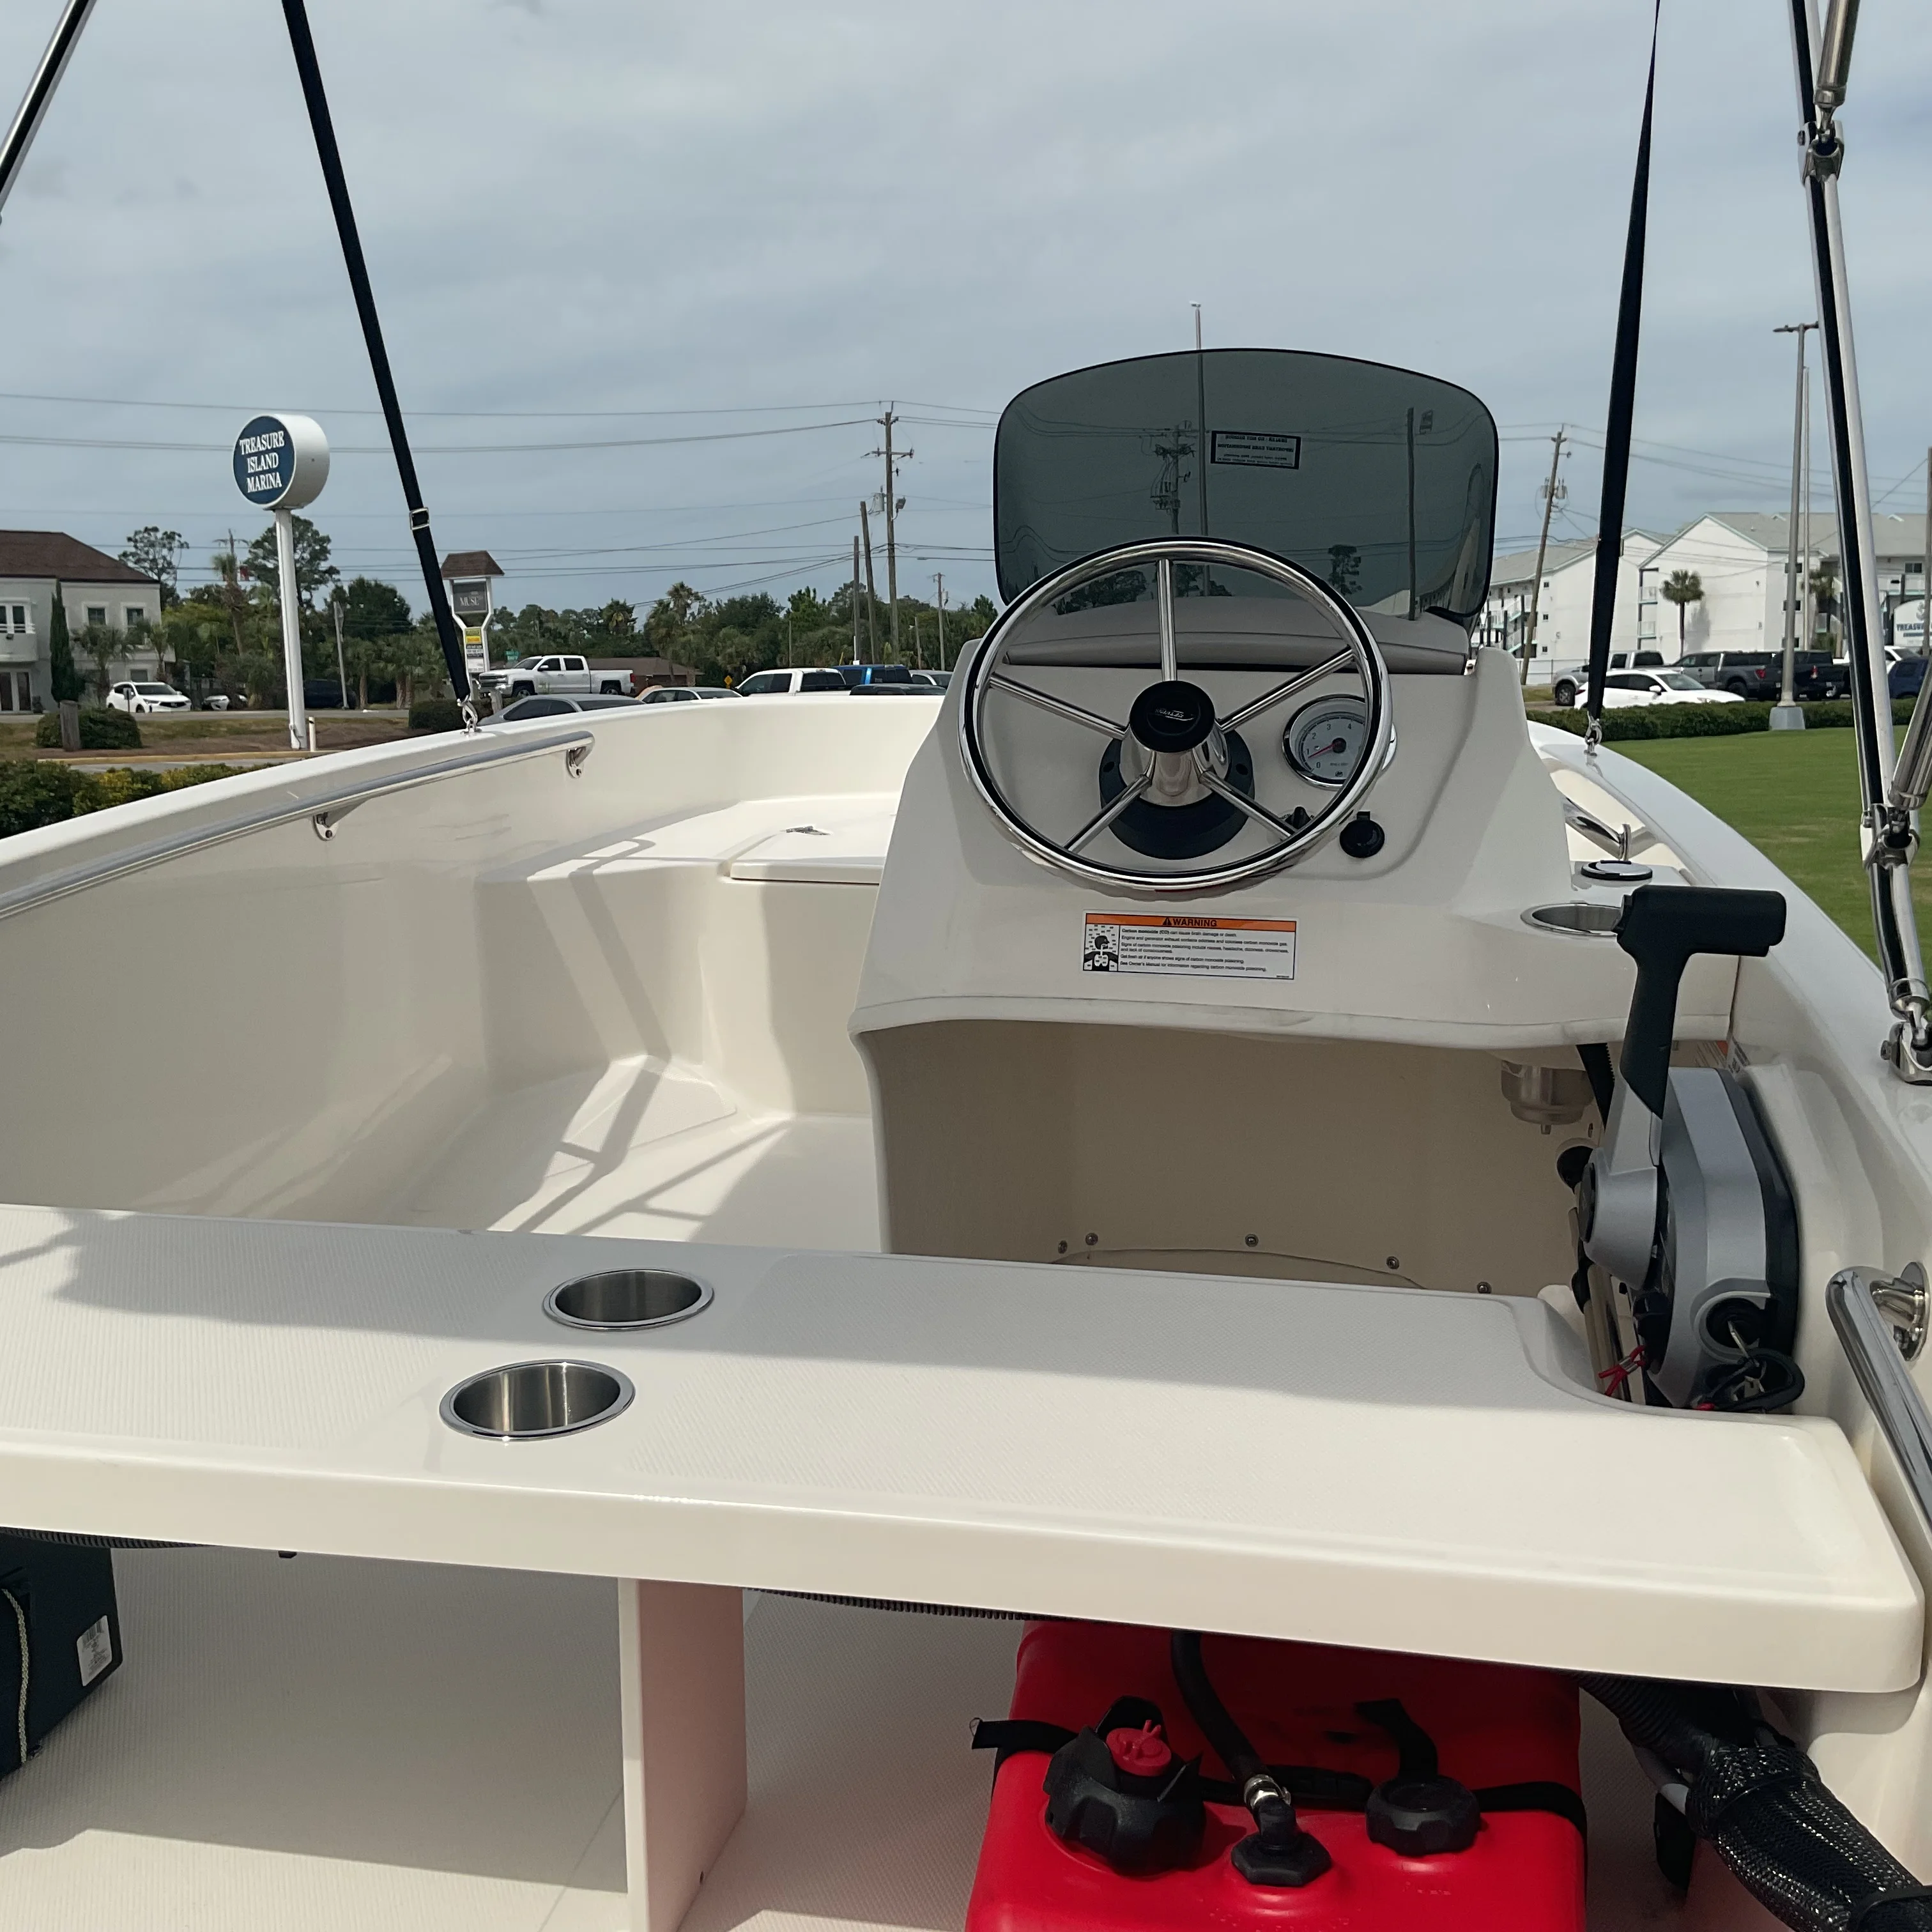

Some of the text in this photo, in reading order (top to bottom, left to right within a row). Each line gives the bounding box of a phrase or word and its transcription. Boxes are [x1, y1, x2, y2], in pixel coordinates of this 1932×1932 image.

[240, 431, 285, 455] TREASURE
[247, 452, 279, 473] ISLAND
[247, 471, 282, 493] MARINA
